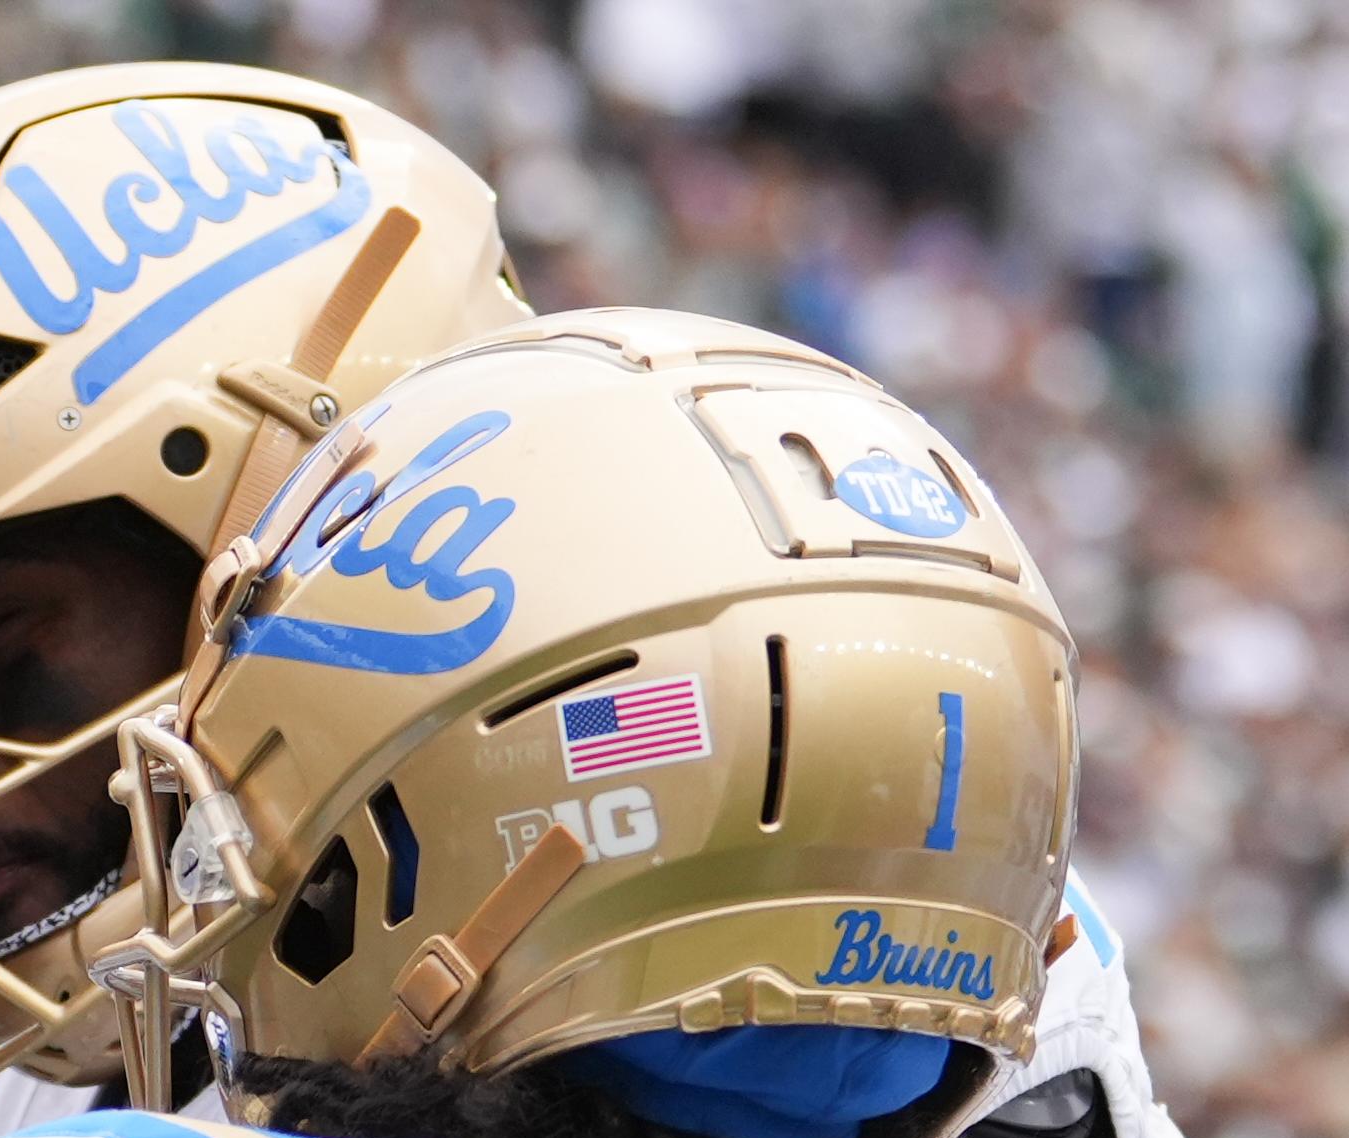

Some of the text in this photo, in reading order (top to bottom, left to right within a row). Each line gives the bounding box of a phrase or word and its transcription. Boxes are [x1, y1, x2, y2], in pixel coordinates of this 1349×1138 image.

[226, 402, 516, 675] cla
[924, 692, 964, 852] 1
[814, 909, 995, 1000] Bruins
